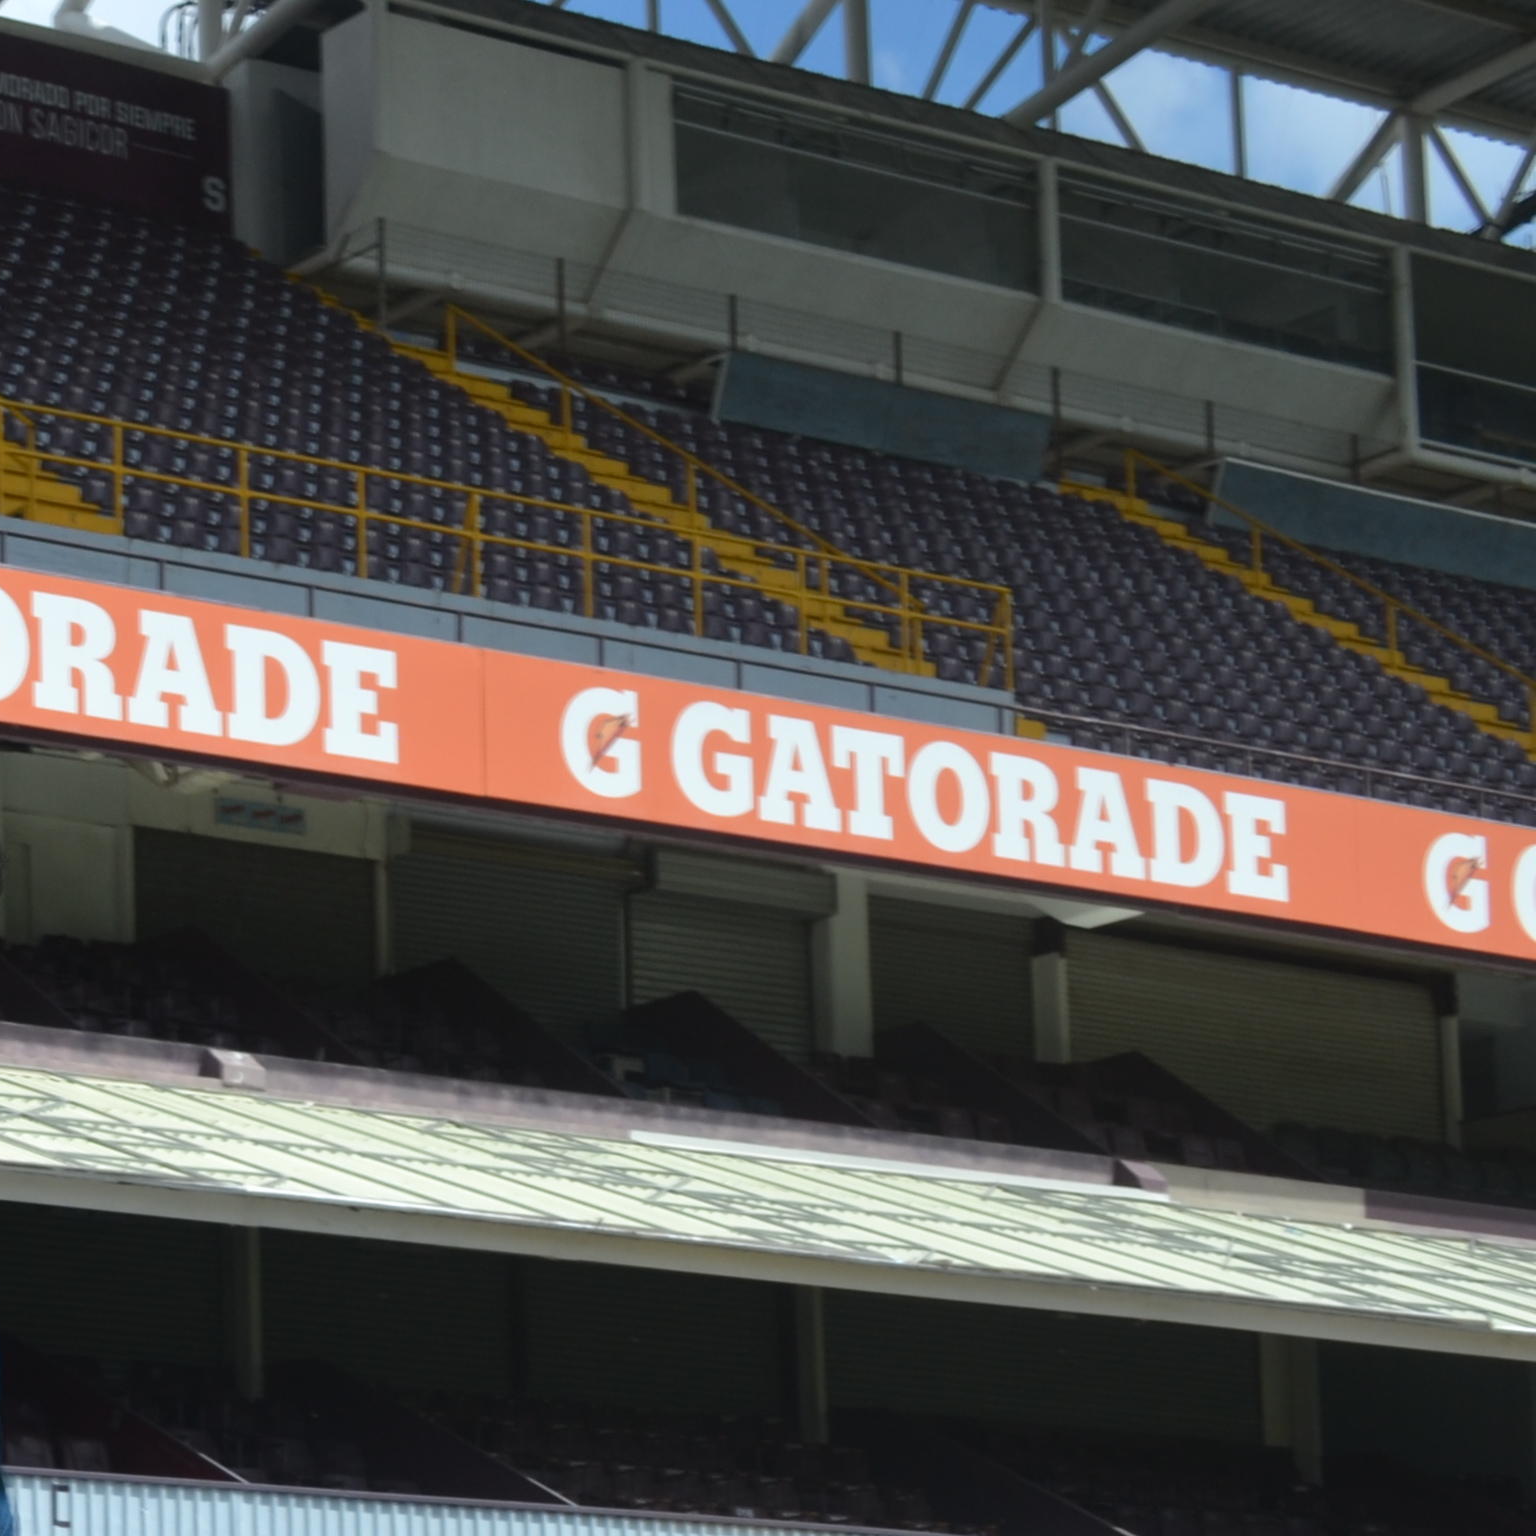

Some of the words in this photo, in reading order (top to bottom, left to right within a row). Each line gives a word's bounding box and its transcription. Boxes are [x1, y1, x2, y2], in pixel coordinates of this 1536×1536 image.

[28, 108, 130, 160] SAGICOR
[73, 90, 112, 121] POR
[114, 101, 199, 142] SIEMPRE
[201, 175, 228, 213] S
[560, 687, 642, 799] G
[671, 701, 1290, 903] GATORADE
